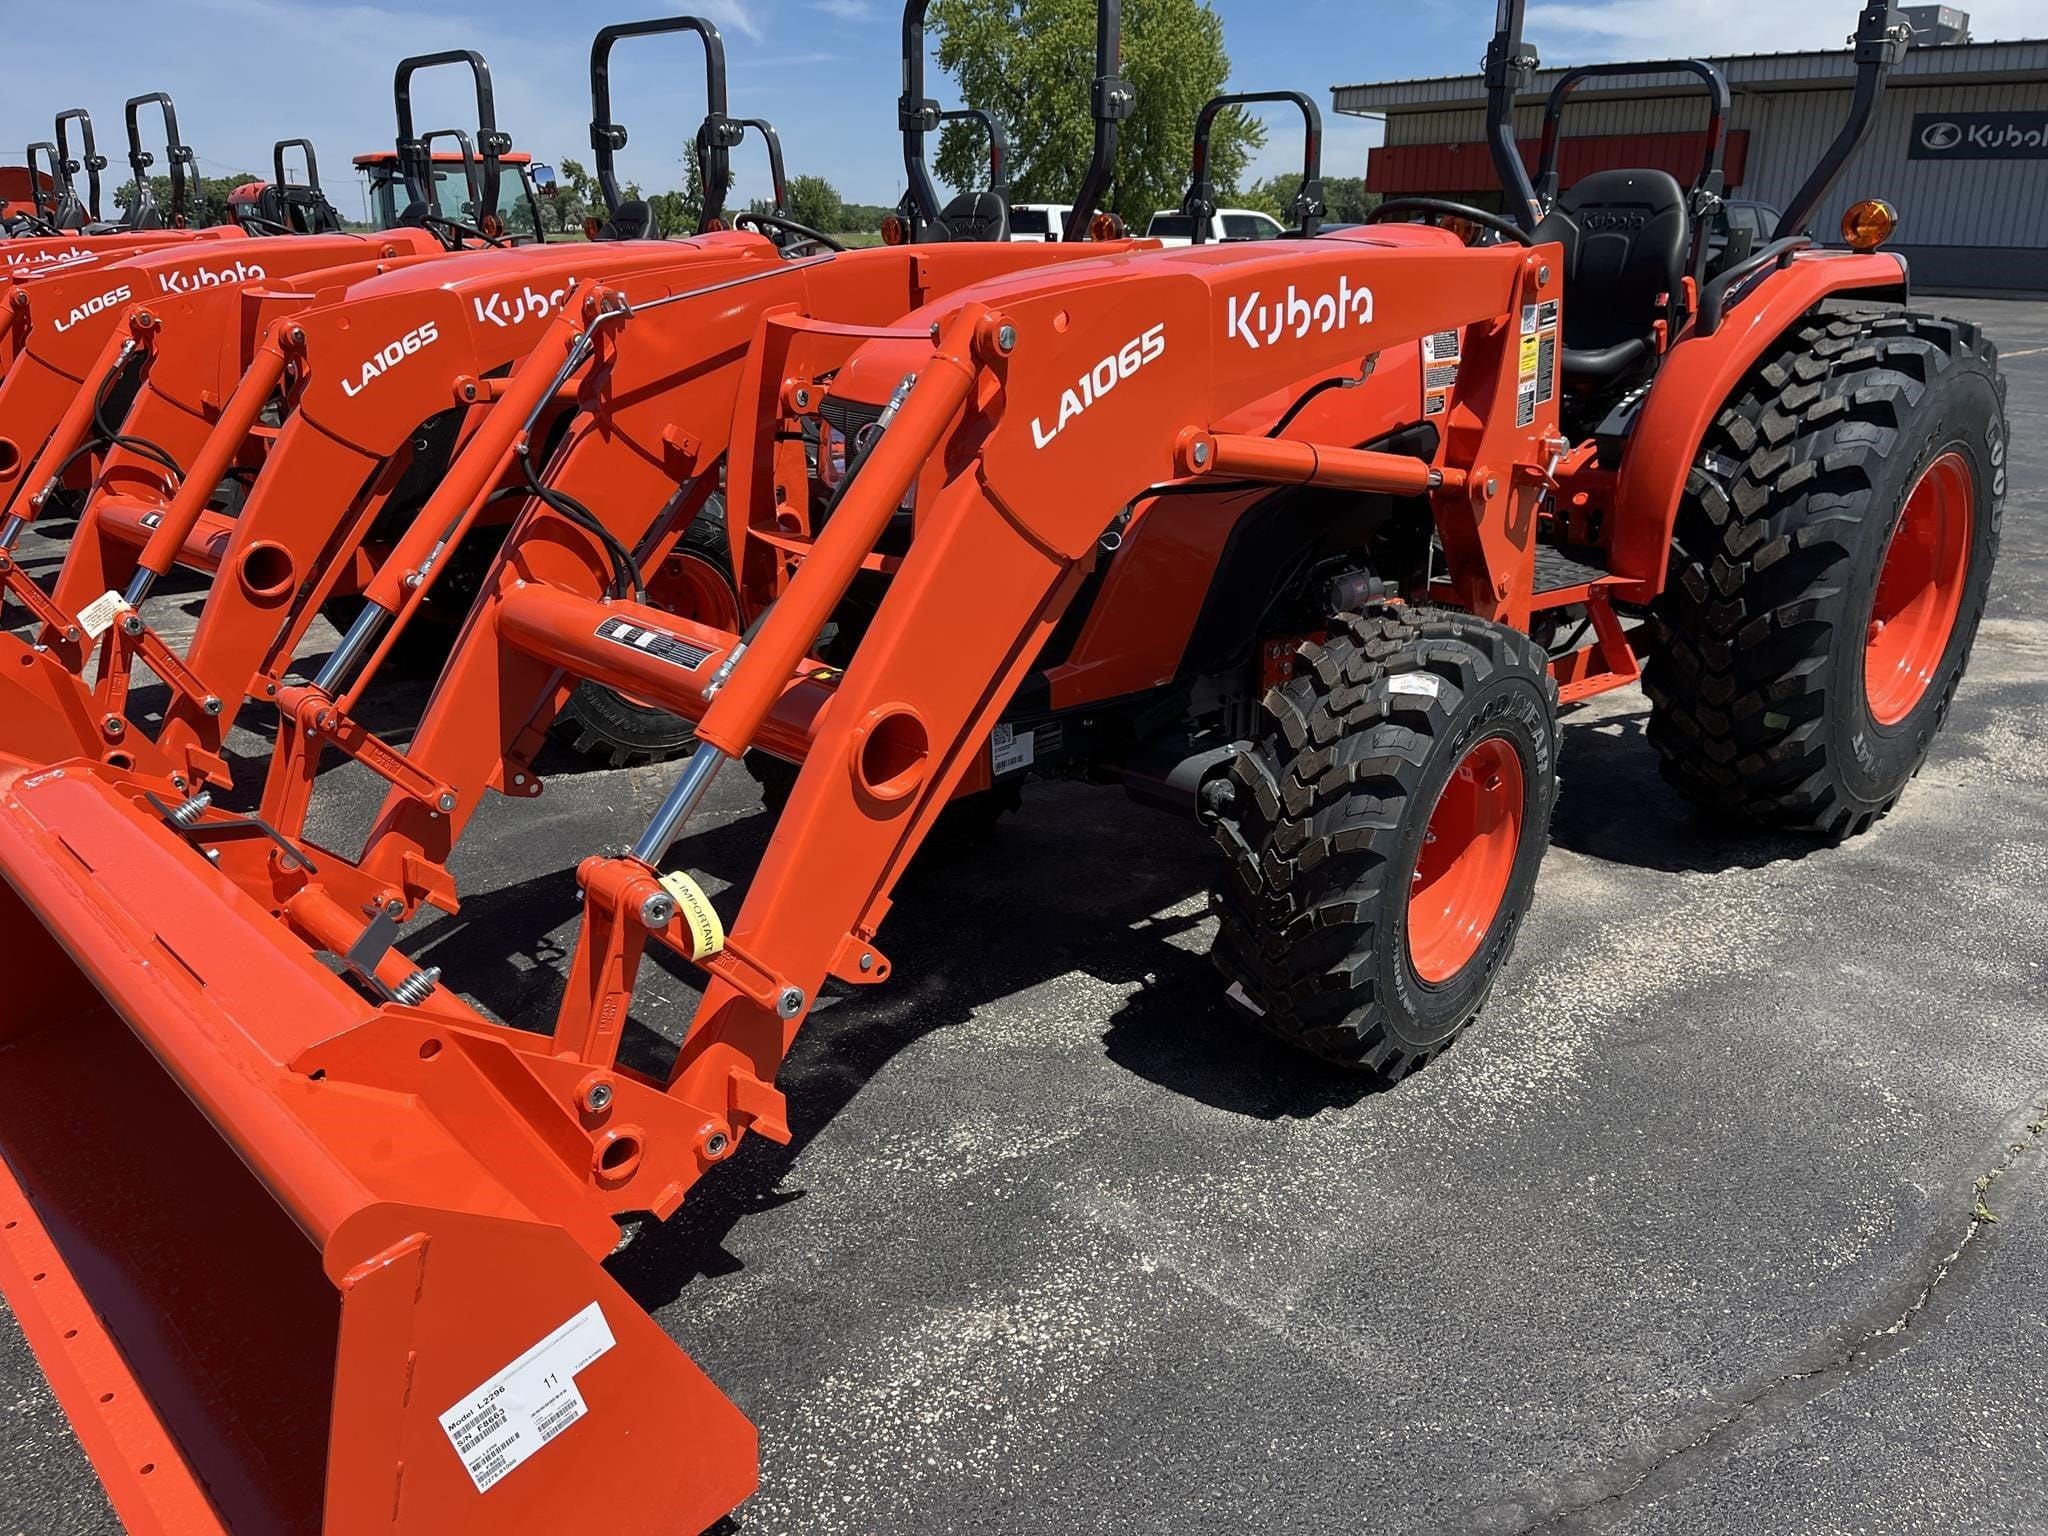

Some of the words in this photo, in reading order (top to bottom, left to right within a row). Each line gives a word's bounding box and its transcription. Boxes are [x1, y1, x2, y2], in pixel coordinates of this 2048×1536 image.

[1580, 210, 1645, 231] Kubota
[54, 285, 132, 333] LA1065
[1228, 275, 1374, 350] Kubota
[341, 321, 439, 397] LA1065
[1031, 322, 1165, 450] LA1065
[1449, 690, 1549, 776] GOODYEAR
[679, 885, 714, 953] IMPORTANT
[447, 1409, 475, 1432] Model
[477, 1385, 506, 1410] L2296
[543, 1372, 559, 1389] 11
[456, 1433, 473, 1448] S/N
[477, 1408, 506, 1432] F8663
